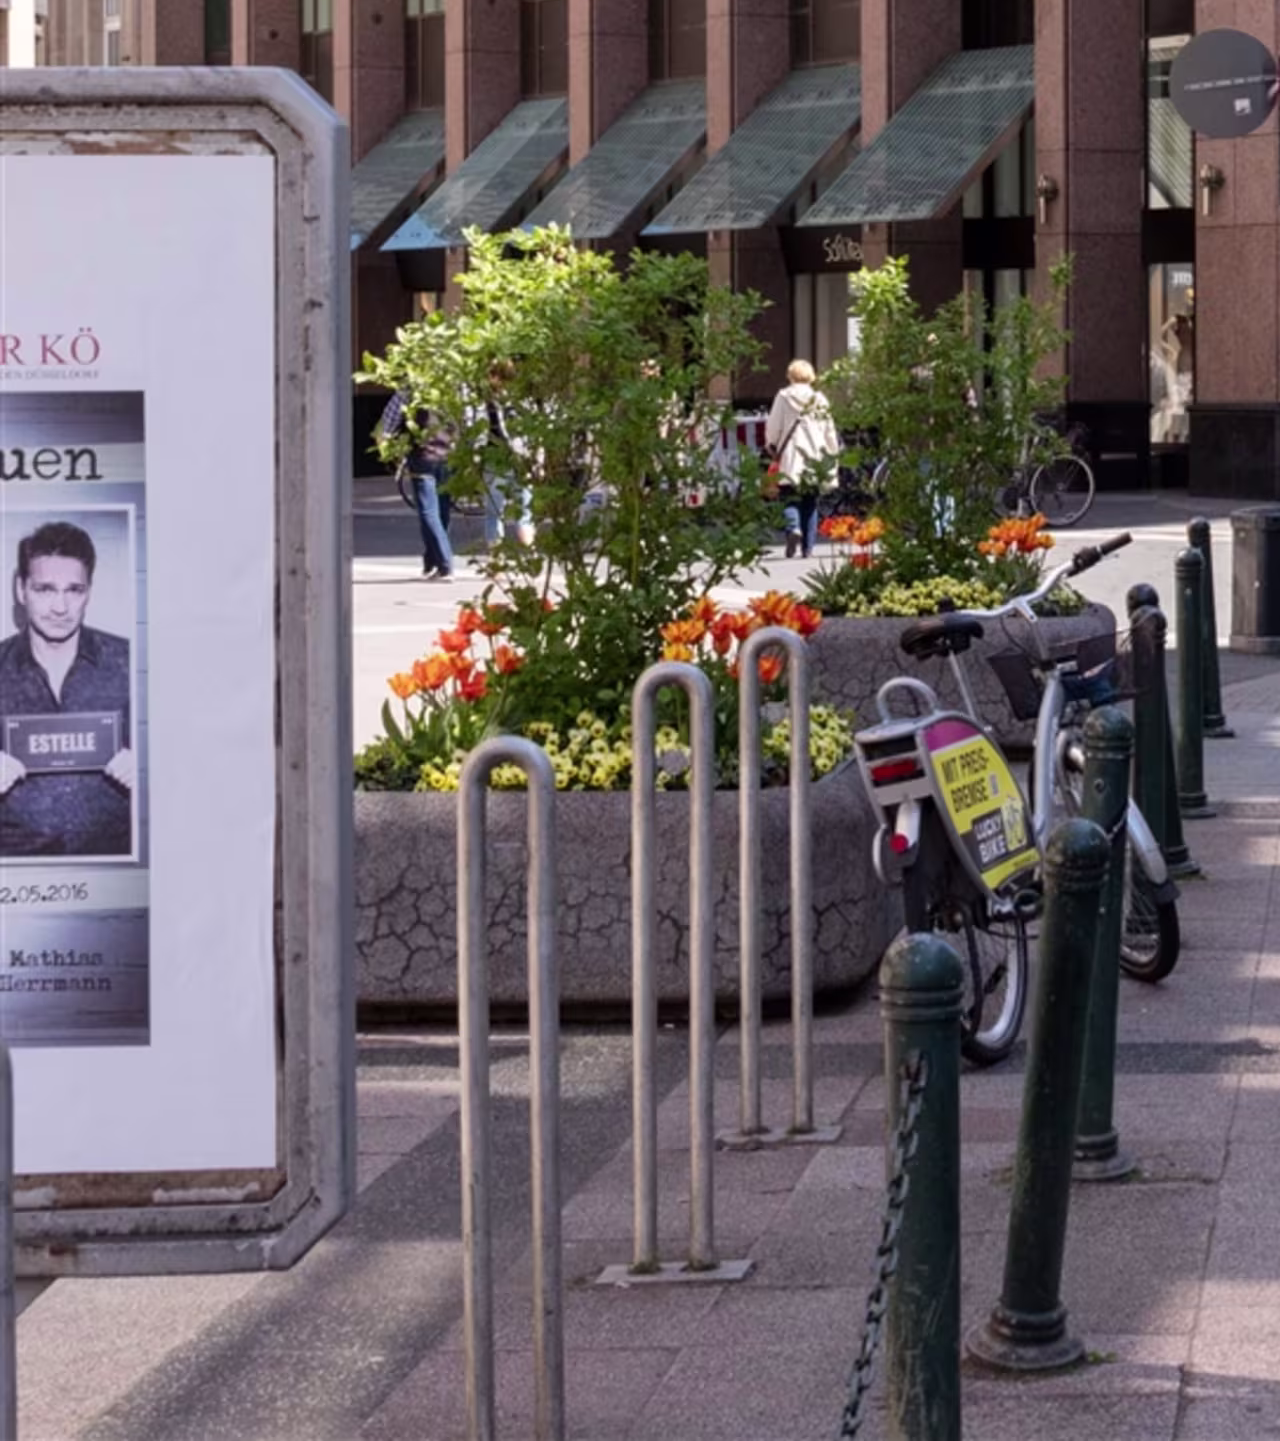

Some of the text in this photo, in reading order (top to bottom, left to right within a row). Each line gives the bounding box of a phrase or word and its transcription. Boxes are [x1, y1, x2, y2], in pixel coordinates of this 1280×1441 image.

[40, 326, 101, 366] KÖ
[28, 731, 97, 754] ESTELLE
[978, 833, 1008, 865] BIKE
[9, 948, 104, 968] Mathias
